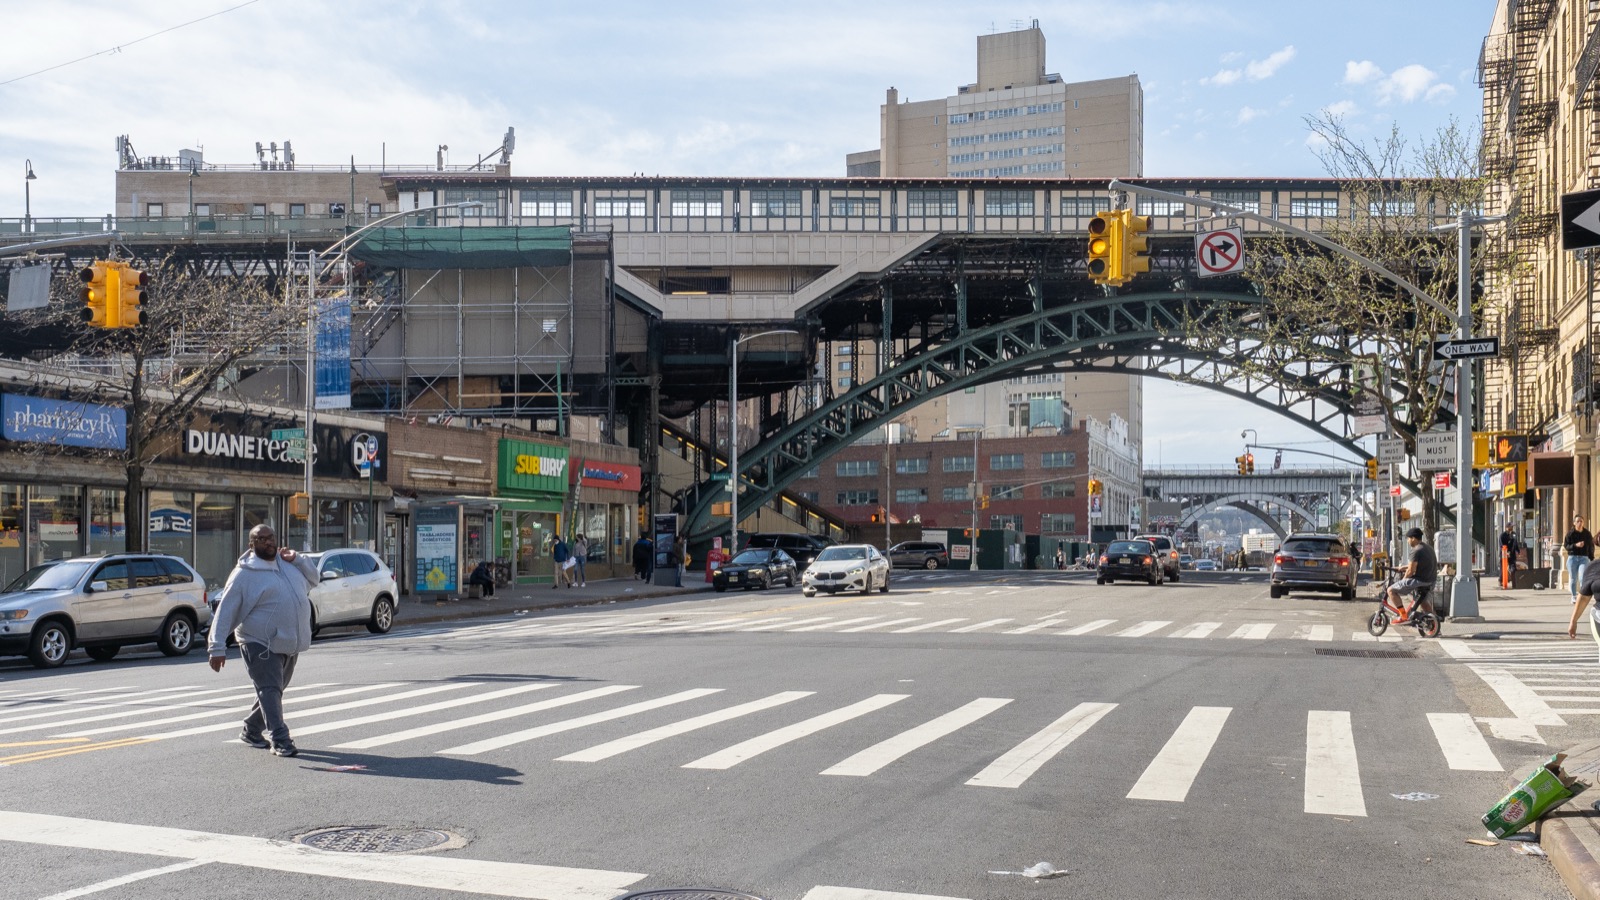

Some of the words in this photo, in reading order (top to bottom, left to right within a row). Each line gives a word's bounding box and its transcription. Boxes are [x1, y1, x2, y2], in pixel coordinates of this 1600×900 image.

[1445, 345, 1464, 354] ONE
[1469, 344, 1490, 352] WAY
[14, 404, 97, 438] pharmacy
[1419, 436, 1437, 444] RIGHT
[1439, 435, 1455, 443] LANE
[188, 429, 255, 459] DUANE
[256, 437, 317, 464] reae
[1426, 446, 1447, 455] MUST
[515, 454, 566, 477] SUBWAY
[1437, 457, 1455, 465] RIGHT
[1503, 800, 1522, 822] CANADA
[1512, 808, 1524, 820] DRY
